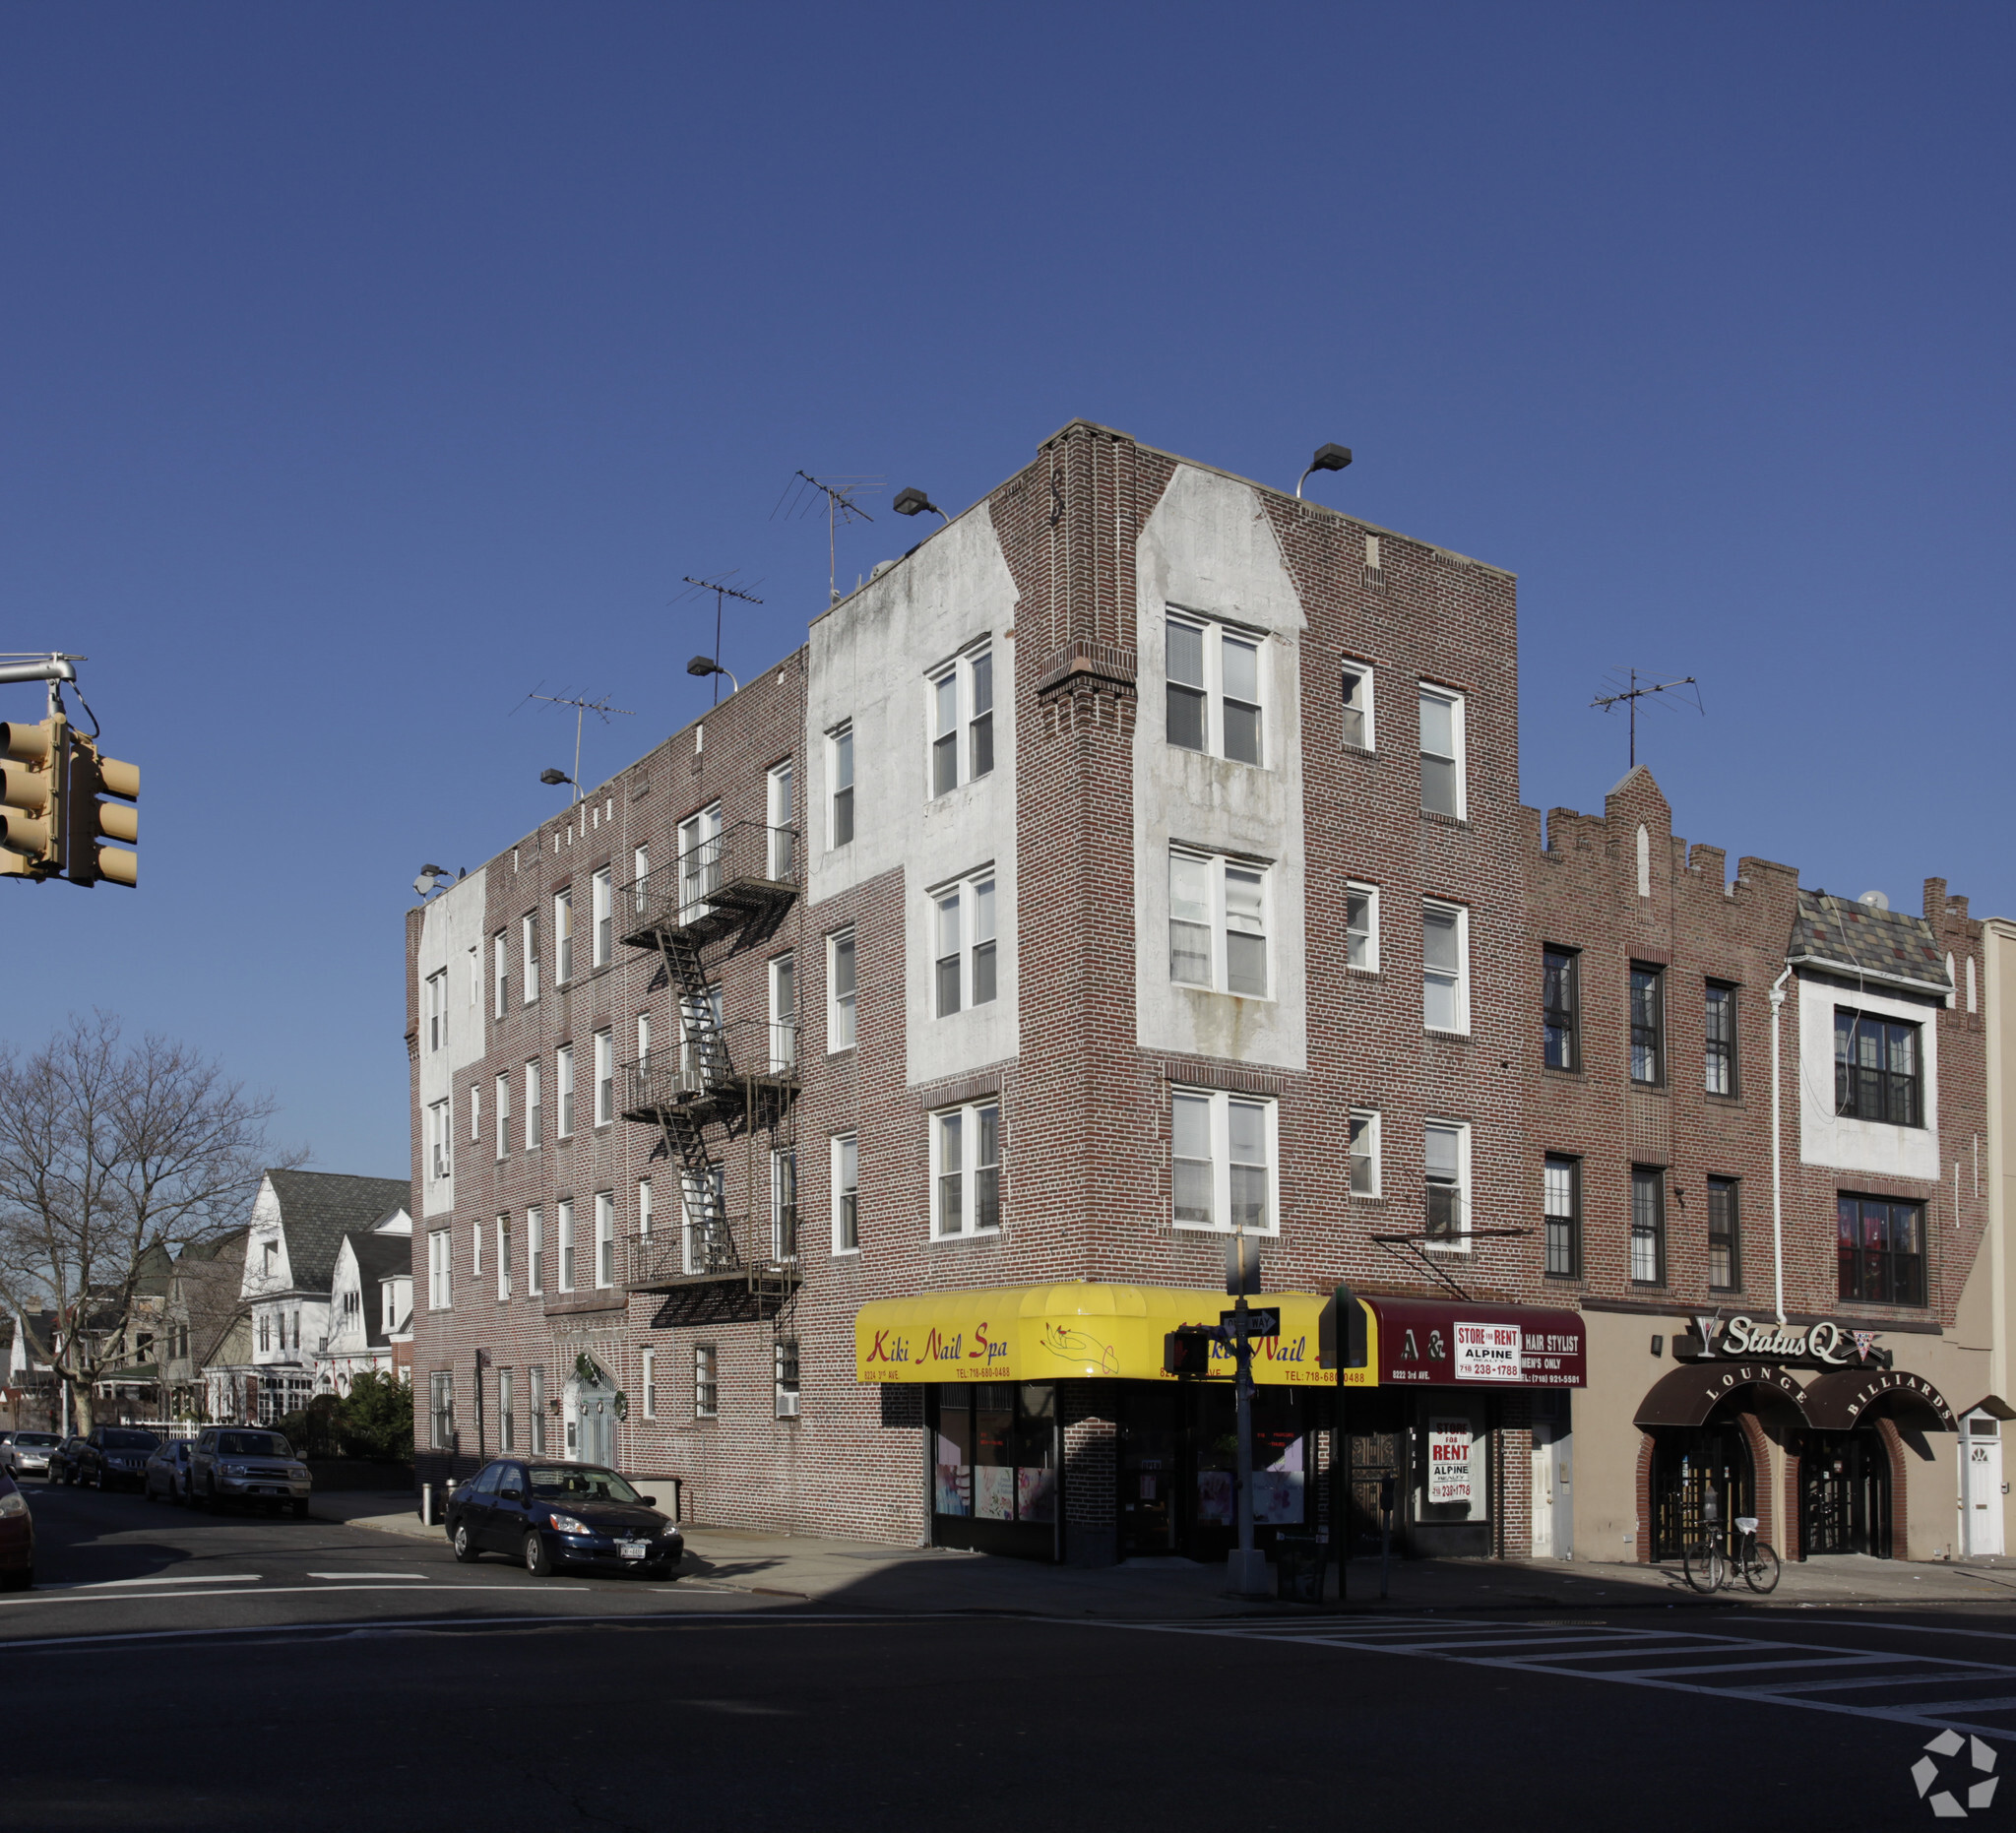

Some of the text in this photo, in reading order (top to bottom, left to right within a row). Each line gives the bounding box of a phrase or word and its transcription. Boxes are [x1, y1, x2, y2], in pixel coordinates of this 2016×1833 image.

[1252, 1317, 1271, 1329] WAY
[1458, 1327, 1485, 1345] STORE
[1494, 1329, 1517, 1347] RENT
[1723, 1315, 1806, 1356] Status
[866, 1322, 1008, 1365] Kiki Nail Spa
[1401, 1329, 1446, 1362] A &
[1526, 1334, 1579, 1353] HAIR STYLIST
[1465, 1349, 1513, 1359] ALPINE
[1474, 1363, 1518, 1376] 238-1788
[1544, 1358, 1561, 1369] ONLY
[1392, 1369, 1431, 1380] 8222 3rd AVE.
[1521, 1373, 1580, 1384] EL: (718) 921-5581
[1706, 1366, 1807, 1405] LOUNGE
[1847, 1373, 1952, 1421] BILLIARDS
[1436, 1422, 1468, 1435] STORE
[1432, 1444, 1470, 1461] RENT
[1433, 1466, 1469, 1475] ALPINE
